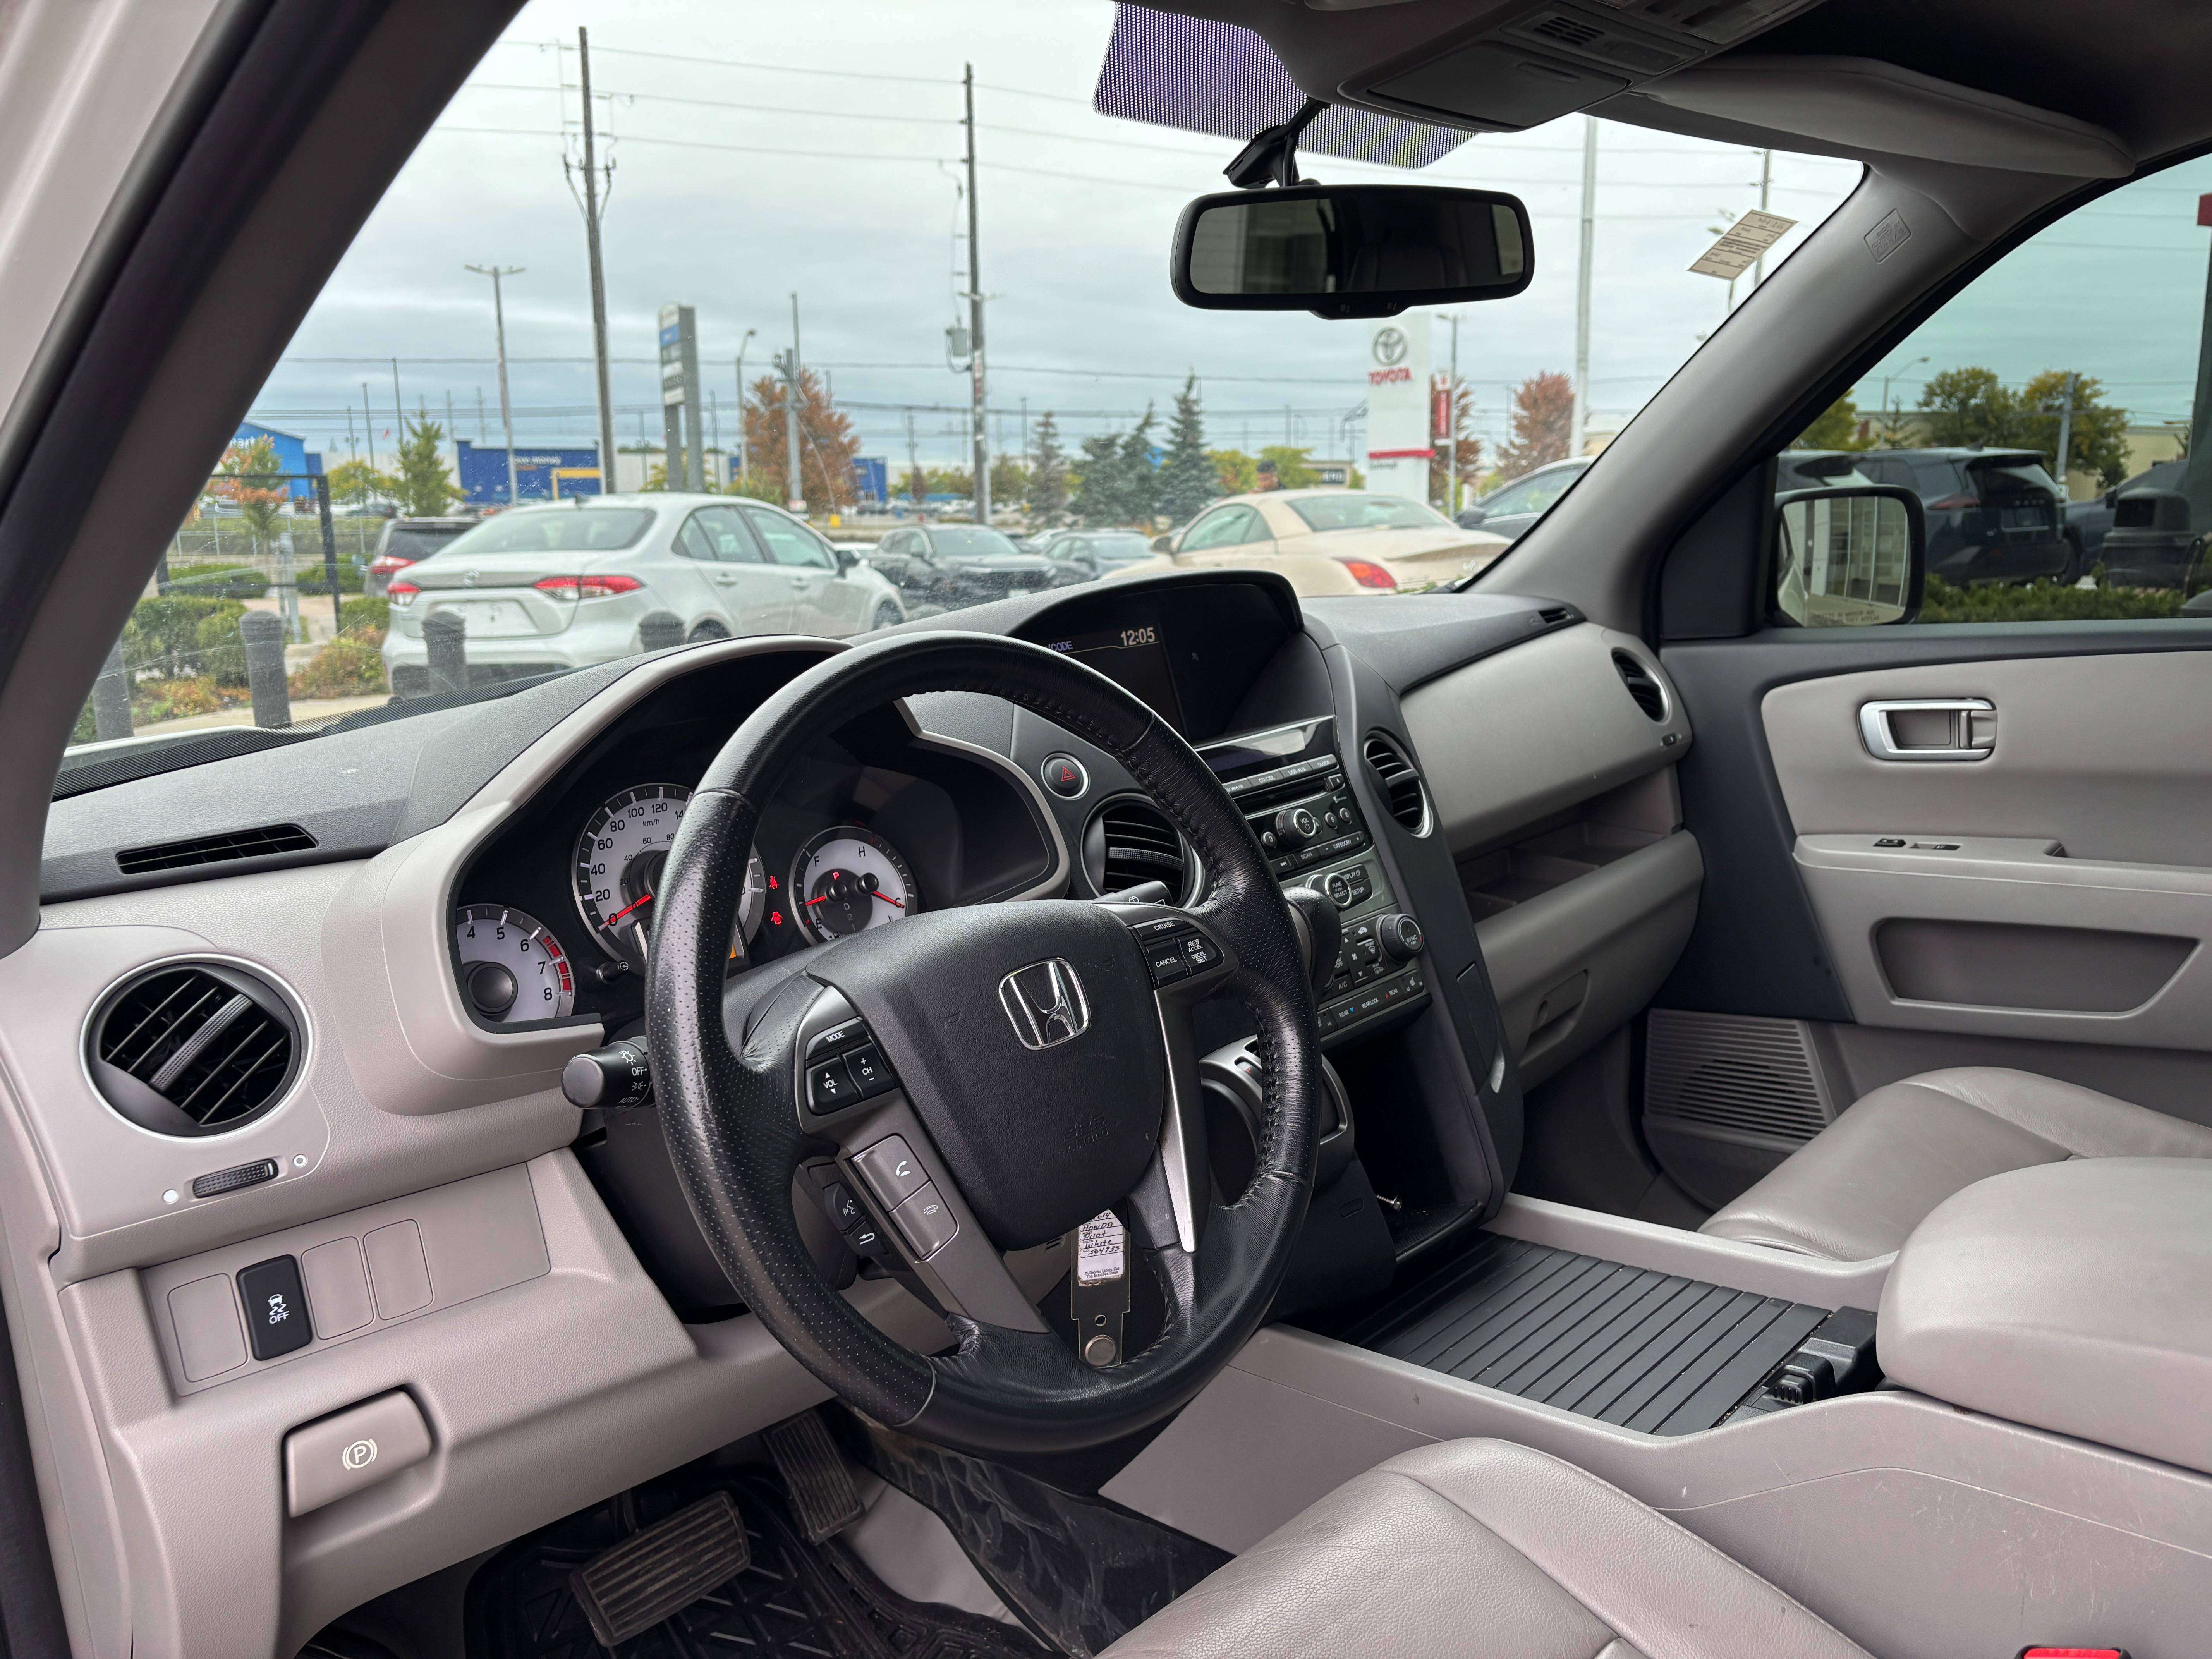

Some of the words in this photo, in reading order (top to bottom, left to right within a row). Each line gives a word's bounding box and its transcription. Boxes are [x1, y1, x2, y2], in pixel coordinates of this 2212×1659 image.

[1368, 367, 1412, 385] TOYOTA
[1121, 627, 1156, 646] 12:05
[627, 807, 644, 818] 100
[651, 802, 668, 814] 120
[675, 809, 684, 820] 14
[610, 819, 625, 832] 80
[643, 818, 660, 827] km/h
[598, 838, 613, 850] 60
[1333, 839, 1352, 849] CATEGORY
[858, 846, 866, 857] H
[814, 855, 820, 867] F
[591, 863, 606, 875] 40
[595, 889, 611, 902] 20
[1334, 890, 1347, 898] SELECT
[1352, 886, 1364, 895] SETUP
[895, 897, 901, 908] C
[609, 913, 618, 926] 0
[816, 918, 822, 929] E
[1154, 921, 1175, 931] CRUISE
[466, 927, 476, 939] 4
[496, 927, 505, 940] 5
[1188, 939, 1200, 948] RES
[1406, 935, 1418, 943] SYNC
[520, 939, 529, 952] 6
[1188, 944, 1203, 953] ACCEL
[1191, 951, 1207, 960] DECEL
[538, 961, 546, 975] 7
[1156, 957, 1177, 968] CANCEL
[1338, 981, 1348, 989] A/C
[544, 988, 553, 1000] 8
[1338, 1010, 1350, 1018] REAR
[826, 1031, 845, 1042] MODE
[632, 1066, 644, 1076] OFF
[862, 1066, 873, 1075] CH
[823, 1079, 838, 1088] VOL
[1082, 1222, 1113, 1232] HONDA
[1085, 1240, 1113, 1249] White
[269, 1311, 290, 1324] OFF
[354, 1445, 366, 1463] P
